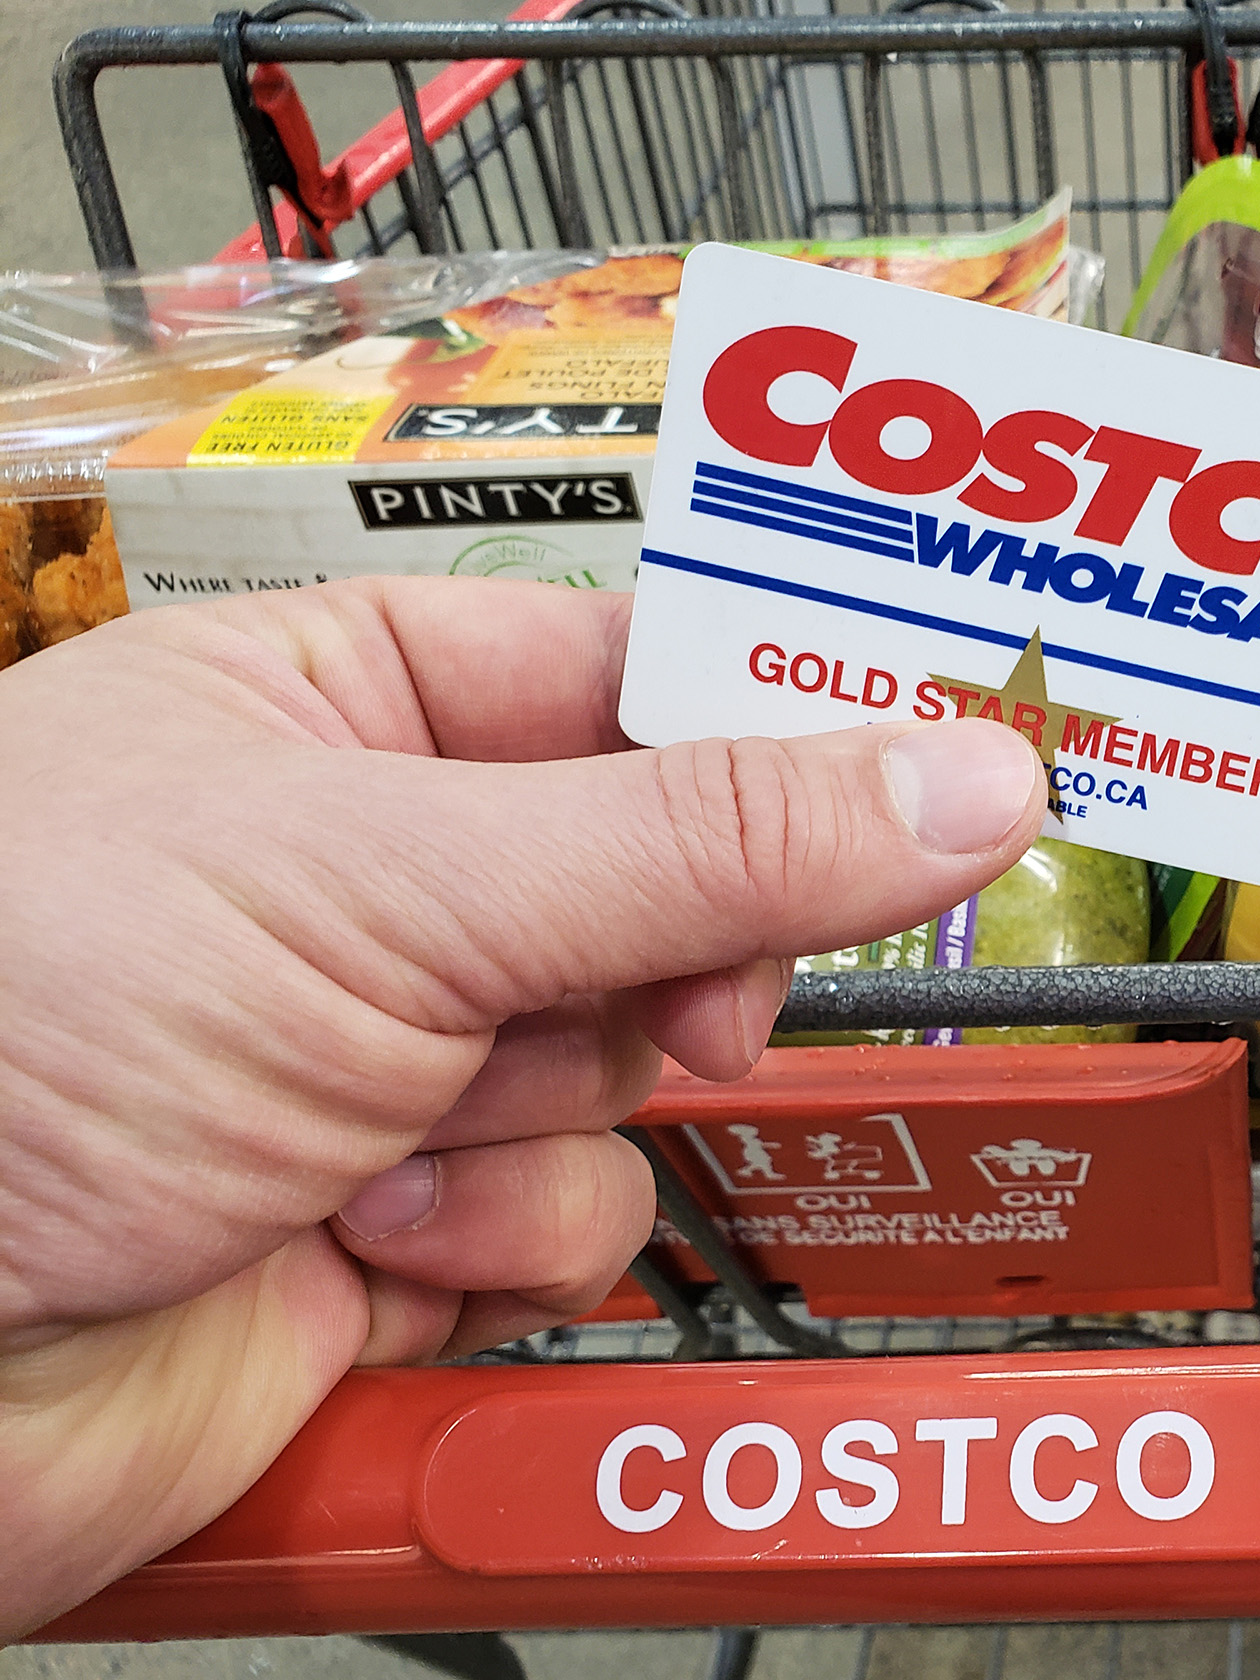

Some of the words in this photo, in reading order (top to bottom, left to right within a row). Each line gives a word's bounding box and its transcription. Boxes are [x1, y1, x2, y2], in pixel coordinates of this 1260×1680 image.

[210, 440, 258, 451] FREE
[266, 440, 349, 451] GLUTEN
[370, 480, 623, 522] PINTY'S
[144, 571, 234, 593] WHERE
[748, 642, 898, 710] GOLD
[912, 680, 1046, 747] STAR
[796, 1193, 871, 1210] OUI
[1000, 1190, 1076, 1207] OUI
[809, 1210, 1062, 1229] SURVEILLANCE
[596, 1410, 1215, 1533] COSTCO
